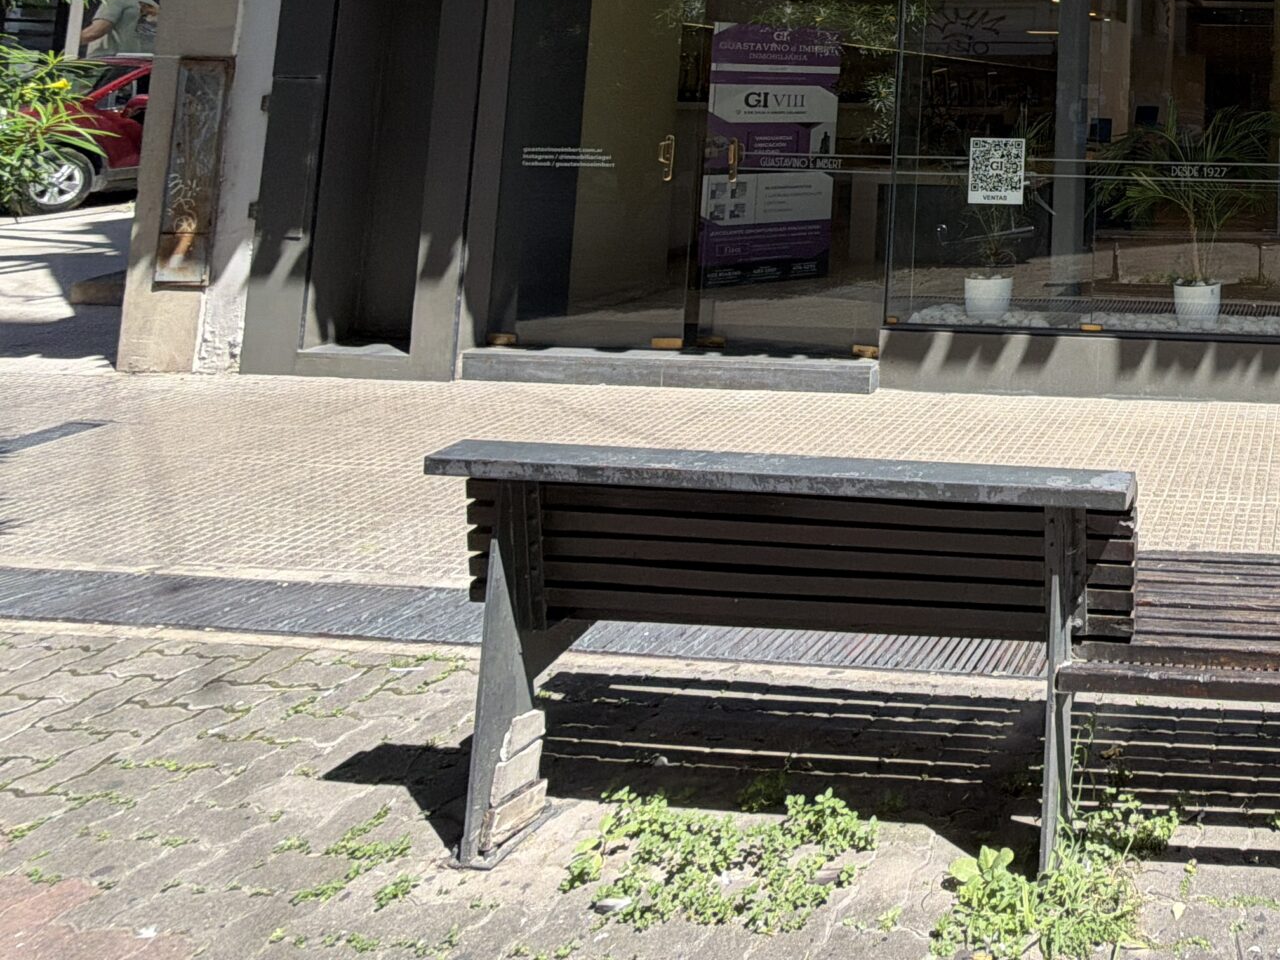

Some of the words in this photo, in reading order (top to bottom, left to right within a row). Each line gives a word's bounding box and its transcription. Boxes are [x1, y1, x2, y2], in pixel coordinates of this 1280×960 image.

[773, 93, 806, 108] VIII
[760, 156, 807, 169] GUASTAVINO
[816, 158, 842, 170] IMBERT
[1171, 165, 1200, 177] DESDE
[1203, 167, 1228, 178] 1927
